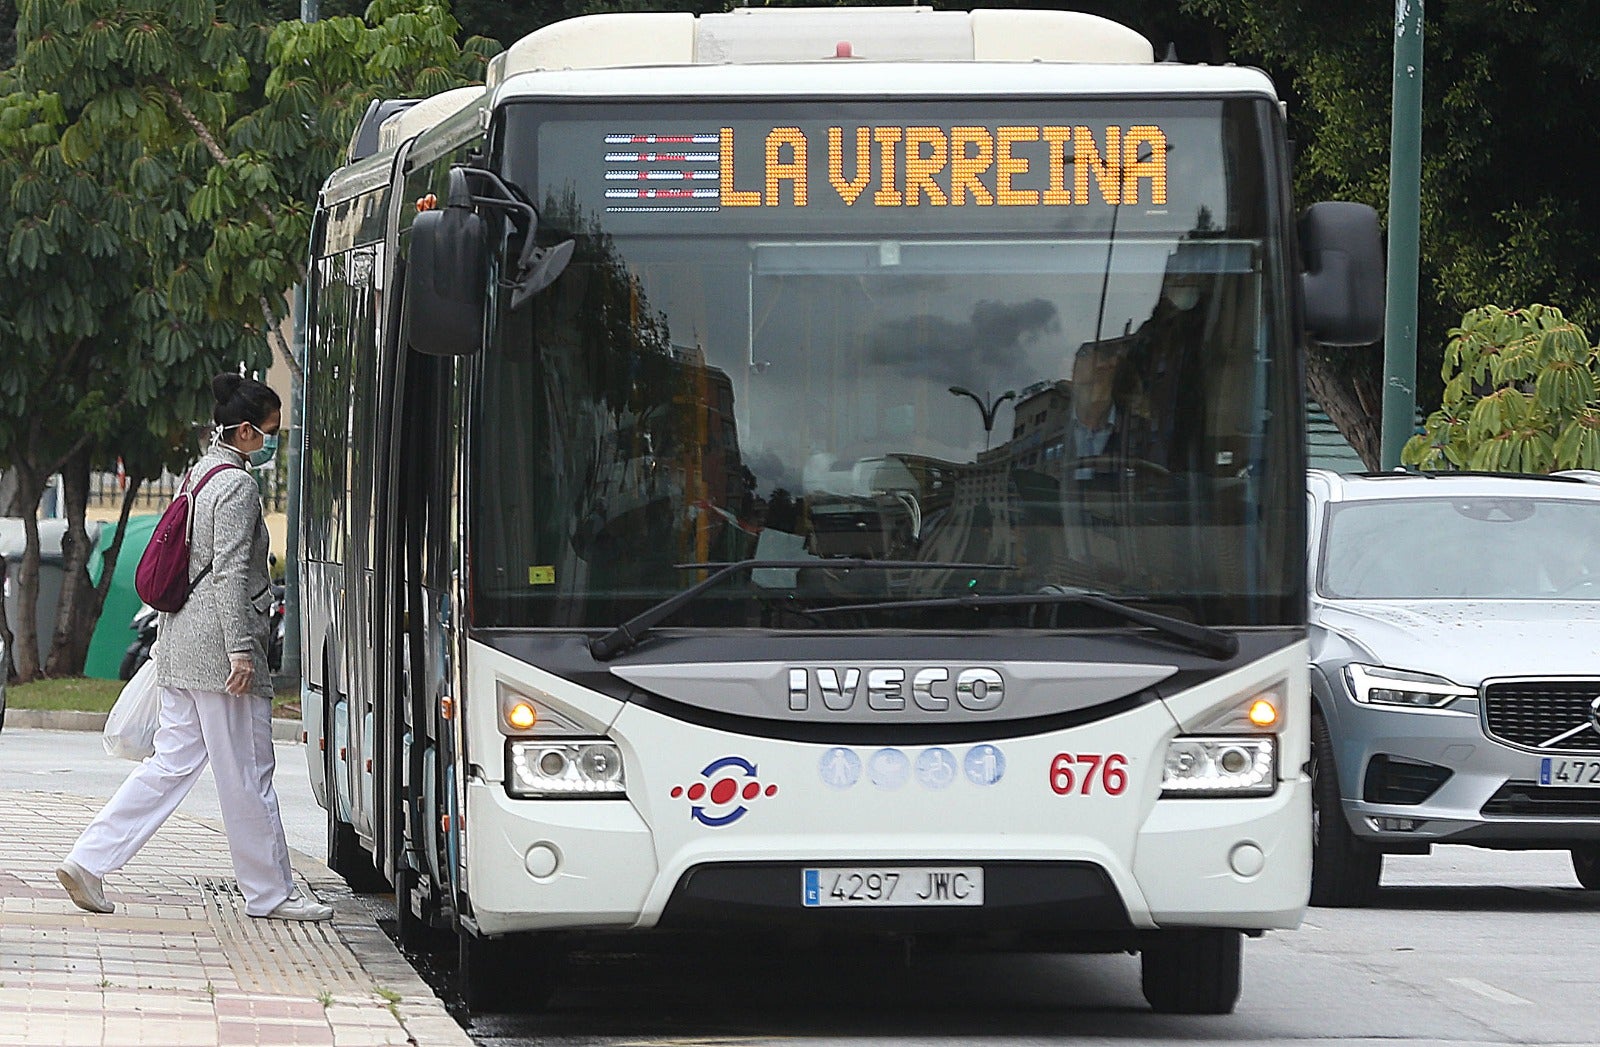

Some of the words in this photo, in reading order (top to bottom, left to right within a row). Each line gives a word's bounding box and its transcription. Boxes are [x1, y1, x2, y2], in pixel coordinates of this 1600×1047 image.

[720, 127, 807, 206] LA
[828, 126, 1168, 206] VIRREINA
[789, 667, 1005, 711] IVECO
[1050, 753, 1128, 796] 676
[830, 873, 900, 900] 4297
[917, 873, 969, 900] JWC
